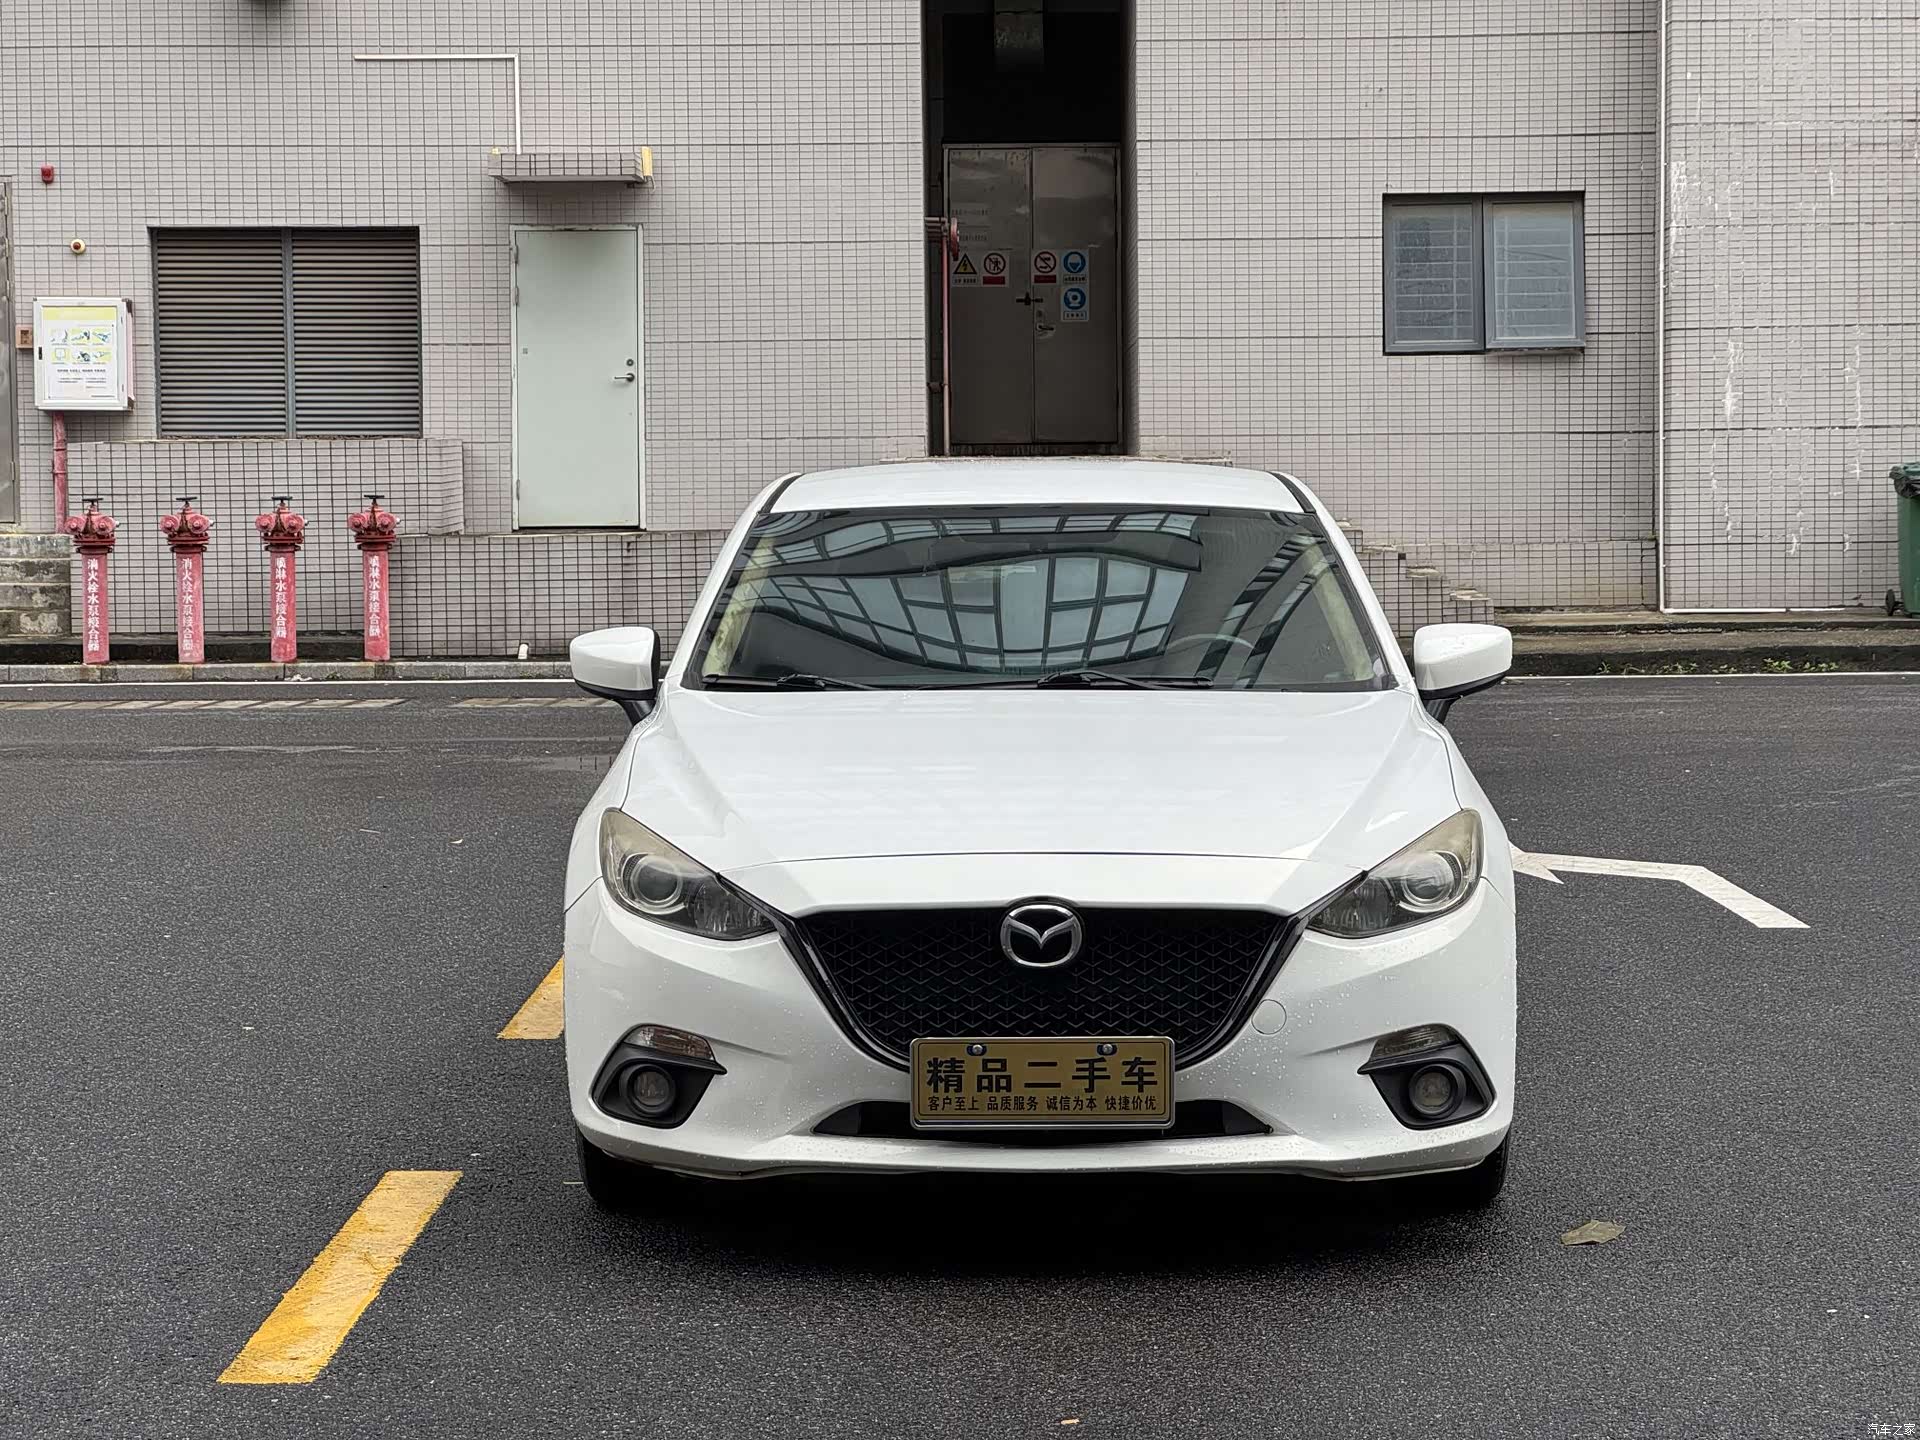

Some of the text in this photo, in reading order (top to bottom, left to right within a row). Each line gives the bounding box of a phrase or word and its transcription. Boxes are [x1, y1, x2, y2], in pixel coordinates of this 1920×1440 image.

[926, 1056, 1158, 1094] 精品二手车
[927, 1095, 1157, 1112] 客户至上 品质服务 诚信为本 快捷价优
